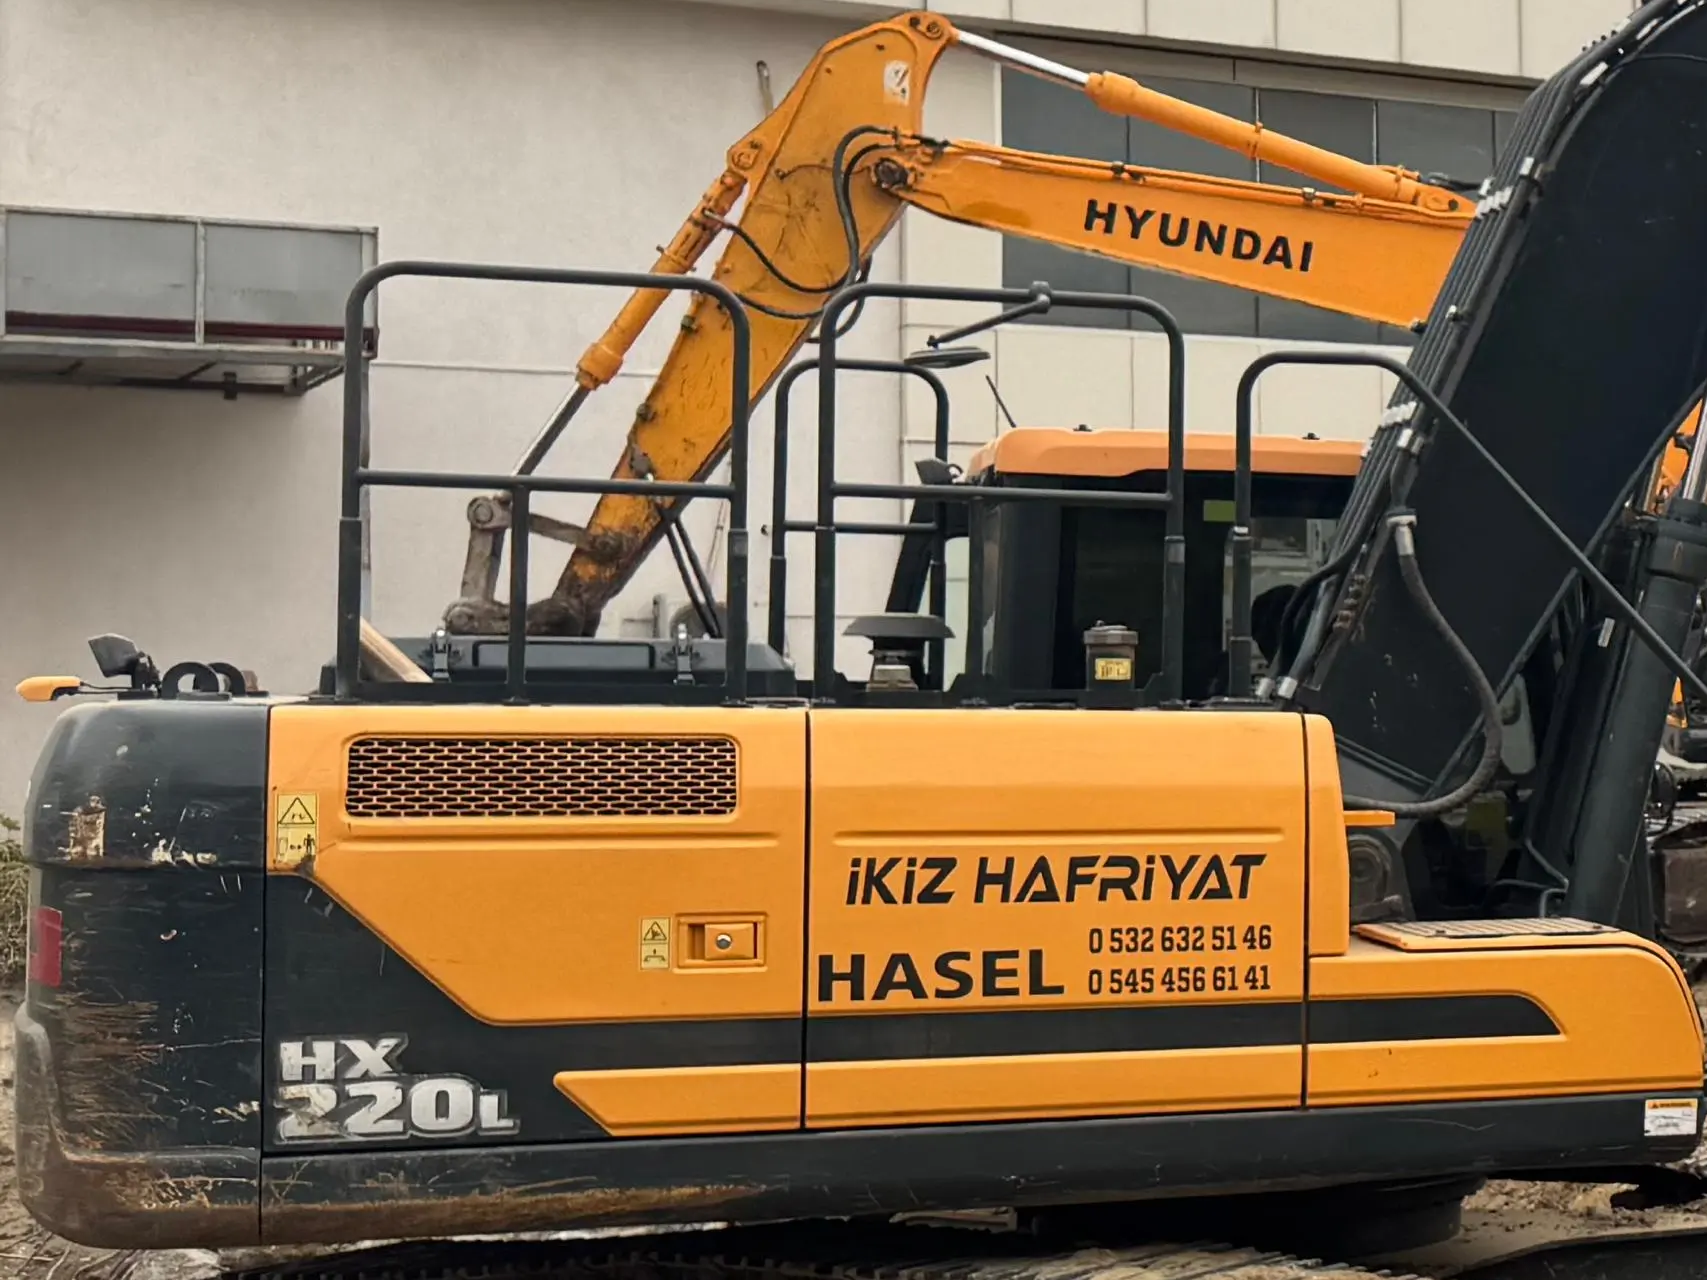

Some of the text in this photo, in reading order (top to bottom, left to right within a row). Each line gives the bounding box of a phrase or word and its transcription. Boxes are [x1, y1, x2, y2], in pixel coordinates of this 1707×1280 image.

[1084, 199, 1313, 272] HYUNDAI
[1110, 927, 1154, 953] 532
[1161, 926, 1205, 952] 632
[818, 950, 1065, 1001] HASEL
[1109, 968, 1154, 994] 545
[1160, 967, 1206, 993] 456
[279, 1037, 404, 1081] HX
[277, 1077, 515, 1138] 220L
